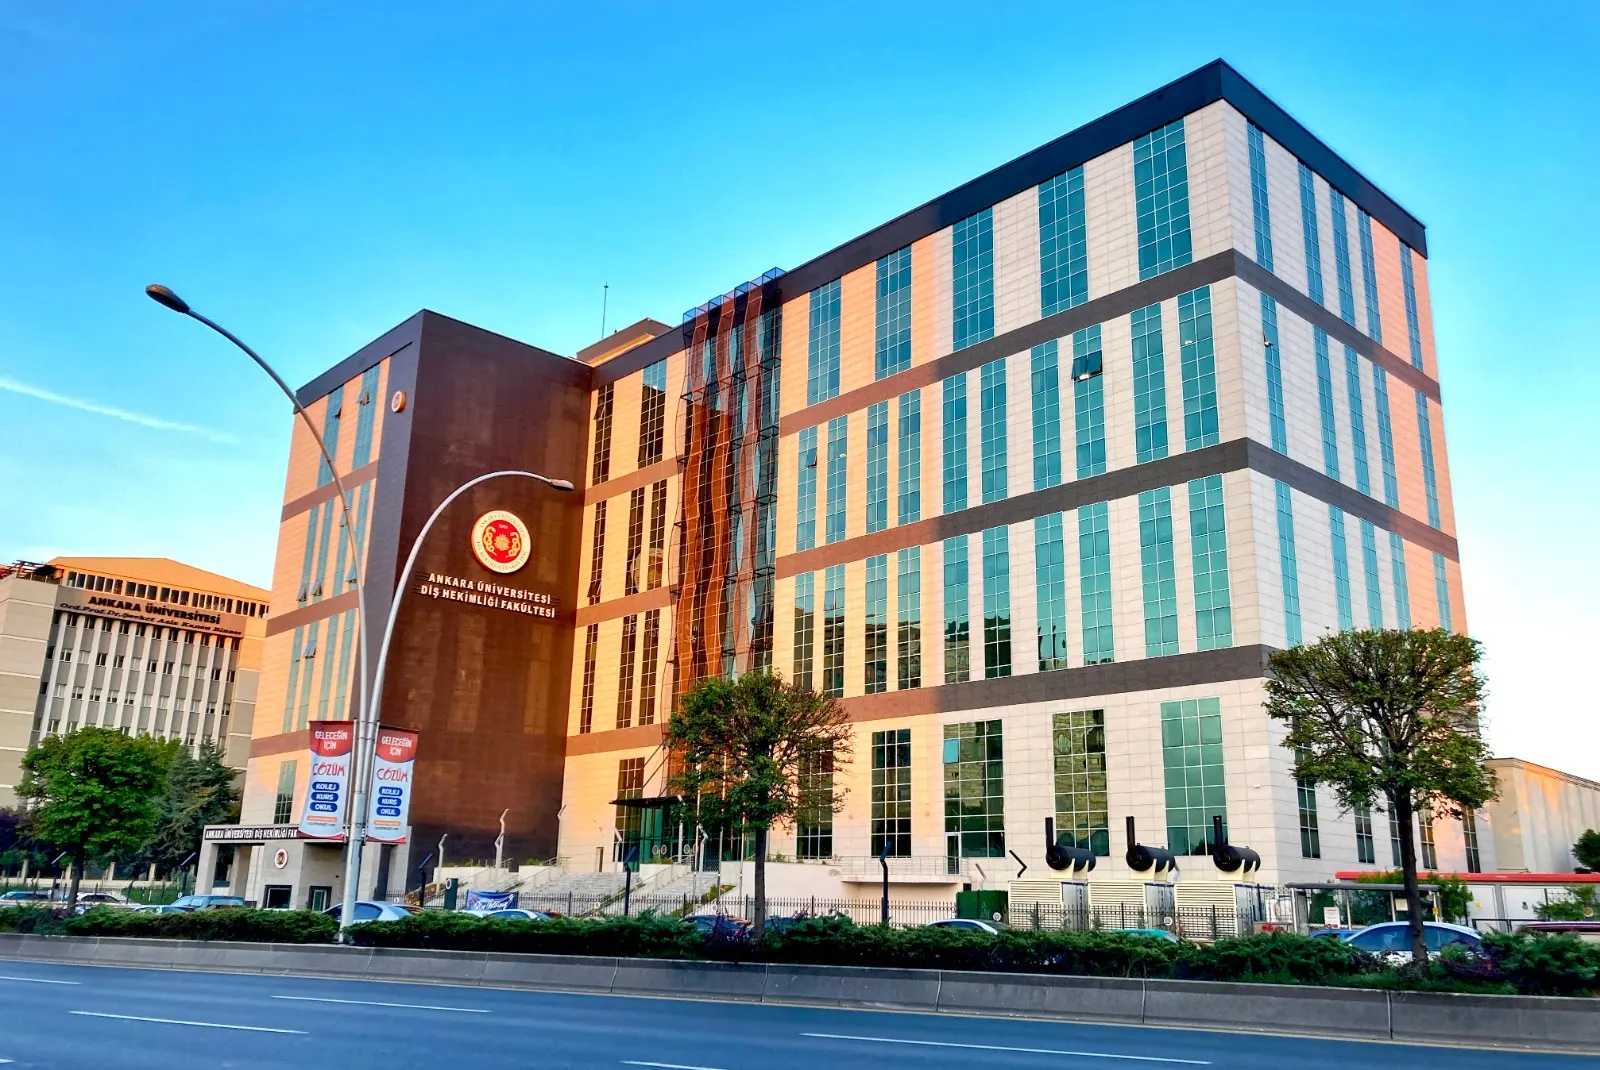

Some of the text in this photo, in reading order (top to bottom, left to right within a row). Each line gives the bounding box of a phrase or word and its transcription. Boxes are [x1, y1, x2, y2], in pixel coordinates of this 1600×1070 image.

[428, 573, 551, 605] ANKARA ÜNİVERSİTESİ
[420, 585, 555, 618] DİŞ HEKİMLİĞİ FAKÜLTESİ
[88, 596, 220, 625] ANKARA ÜNİVERSİTESİ
[314, 730, 348, 740] GELECEĞİN
[323, 740, 337, 750] İÇİN
[381, 735, 412, 748] GELECEĞİN
[389, 745, 401, 757] İÇİN
[381, 787, 400, 795] KOLEJ
[316, 793, 334, 801] KURS
[381, 797, 397, 806] KURS
[380, 808, 396, 816] OKUL
[205, 829, 224, 839] ANKARA
[224, 828, 254, 839] ÜNİVERSİTESİ
[254, 828, 263, 840] DİŞ
[263, 827, 288, 839] HEKİMLİĞİ
